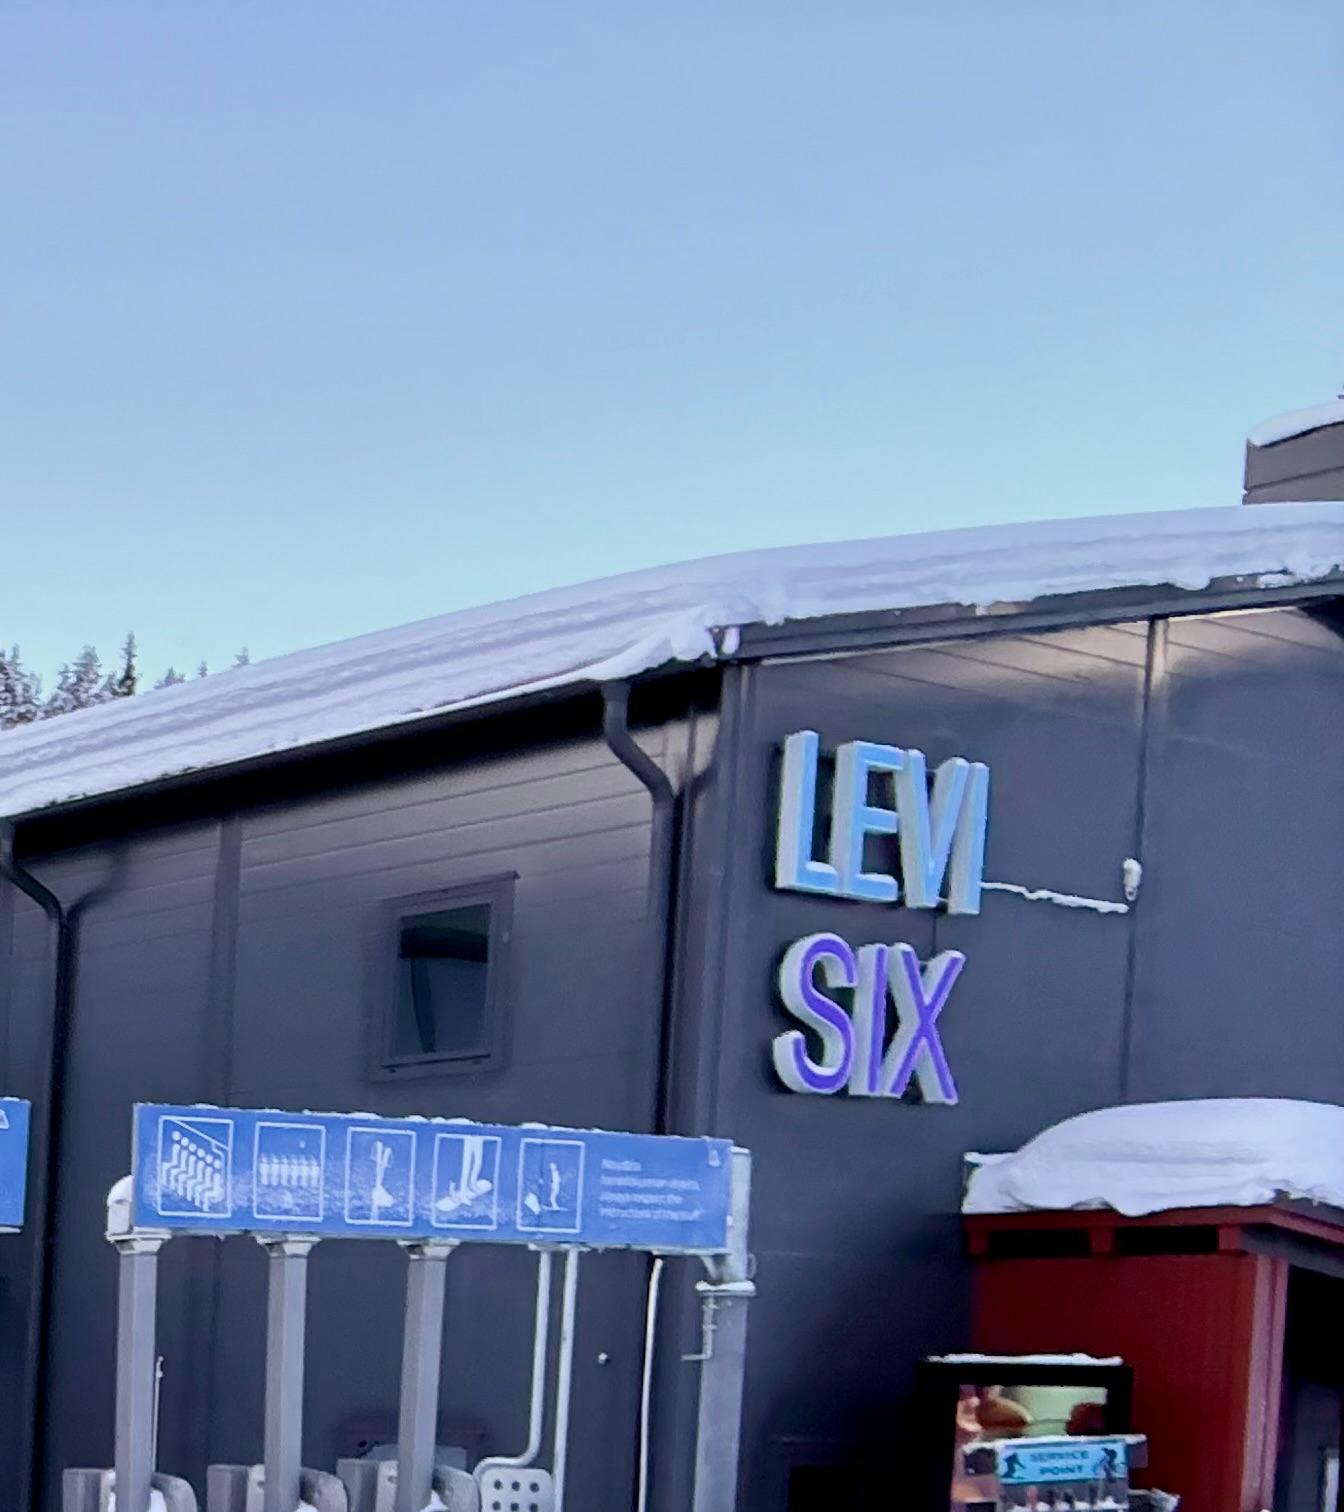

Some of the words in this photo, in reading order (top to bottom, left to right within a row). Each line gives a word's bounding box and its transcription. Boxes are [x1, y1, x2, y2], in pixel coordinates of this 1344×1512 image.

[775, 730, 989, 915] LEVI
[773, 932, 966, 1105] SIX
[1030, 1450, 1089, 1463] SERVICE
[1040, 1464, 1084, 1476] POINT
